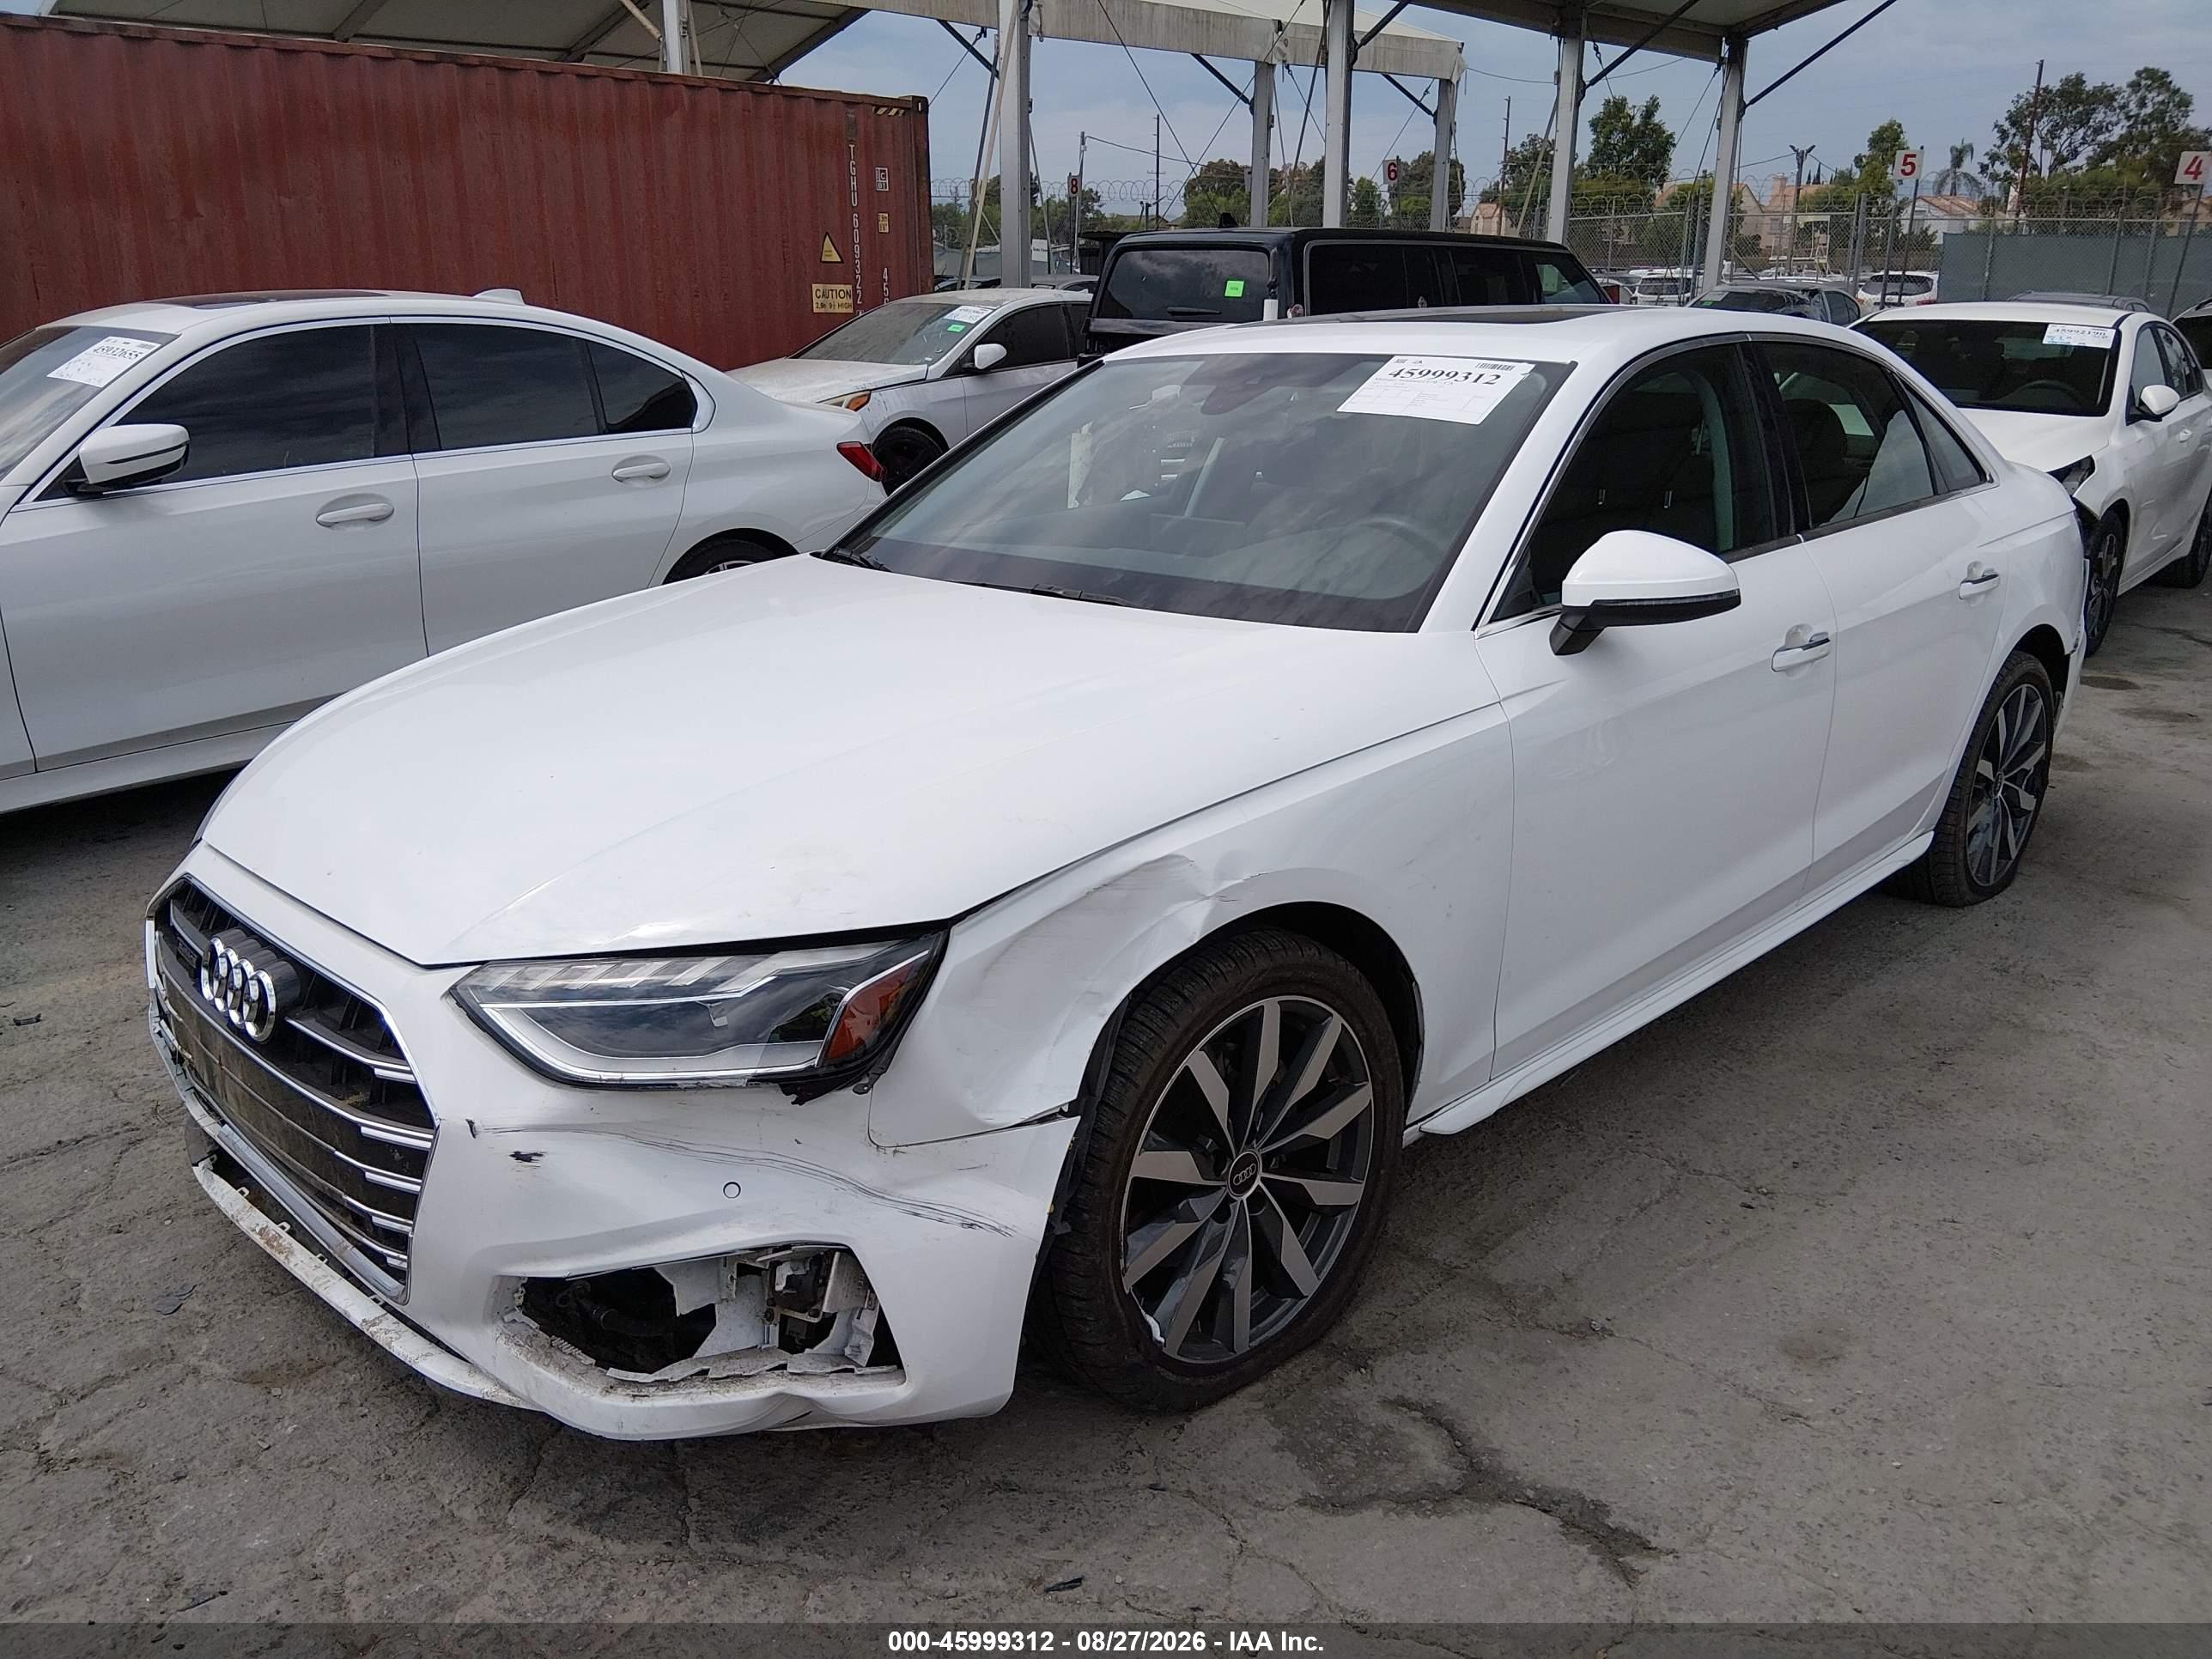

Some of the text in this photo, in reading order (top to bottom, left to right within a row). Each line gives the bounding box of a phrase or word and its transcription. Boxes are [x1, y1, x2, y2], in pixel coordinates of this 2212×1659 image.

[1387, 161, 1398, 181] 6
[1899, 153, 1917, 177] 5
[2184, 155, 2203, 180] 4
[1070, 177, 1079, 195] 8
[848, 144, 858, 207] TGHU
[853, 213, 862, 305] 609322
[814, 288, 852, 300] CAUTION
[1388, 368, 1503, 386] 45999312
